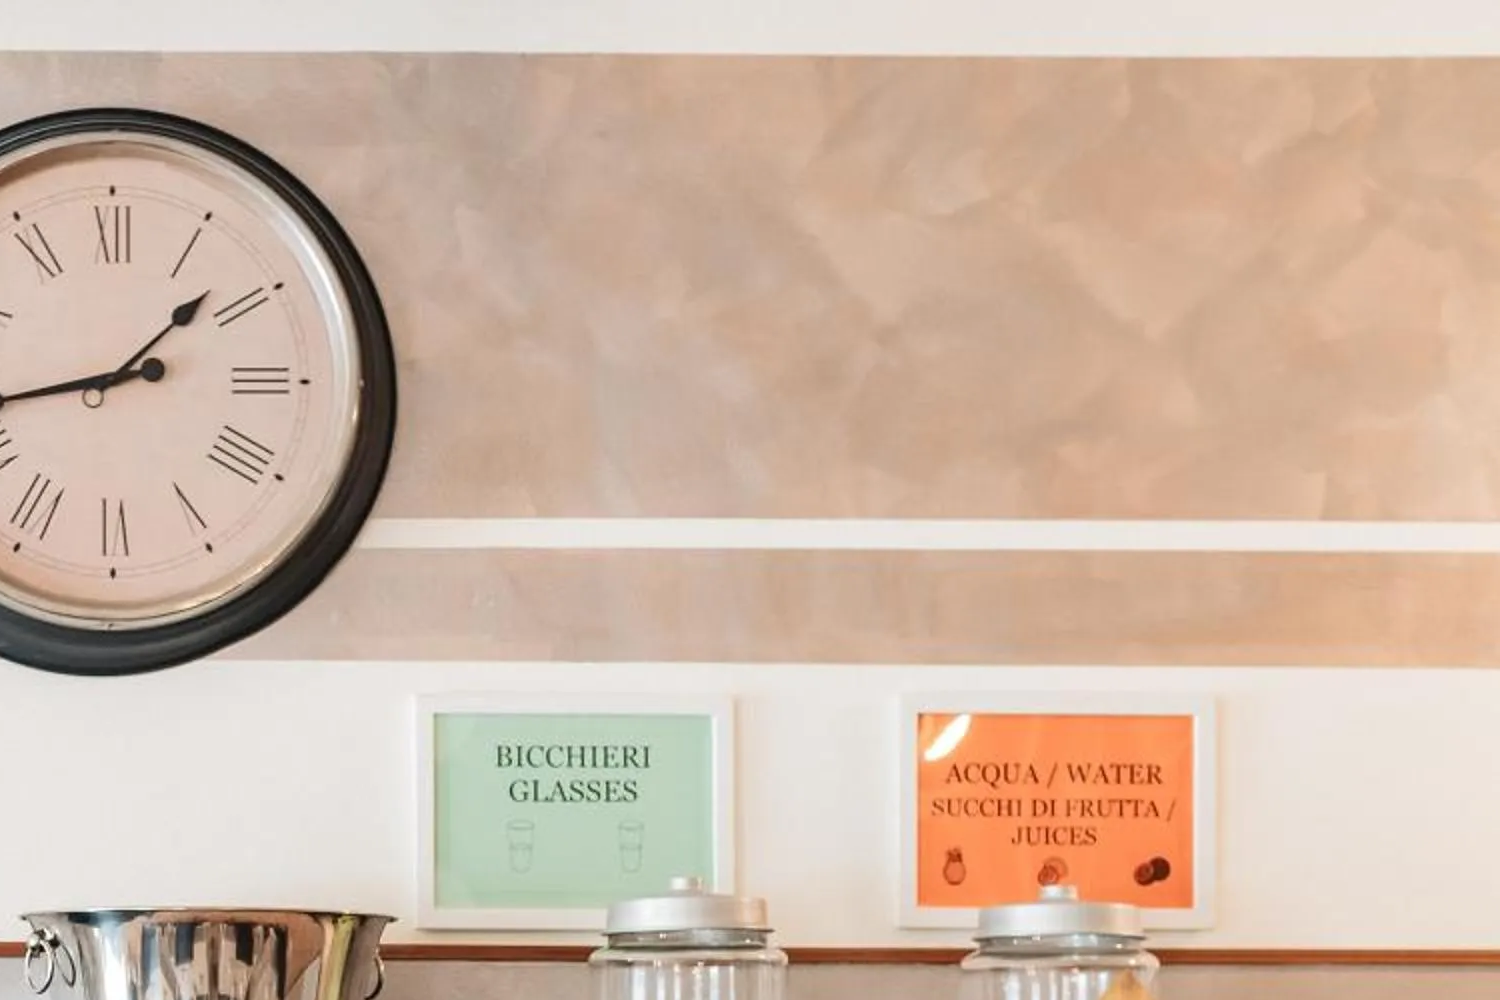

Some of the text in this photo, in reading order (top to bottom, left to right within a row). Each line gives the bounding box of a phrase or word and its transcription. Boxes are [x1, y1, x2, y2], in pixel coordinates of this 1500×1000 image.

[94, 205, 131, 264] XII
[13, 222, 64, 285] XI
[171, 227, 202, 279] I
[213, 287, 269, 328] II
[231, 367, 290, 395] III
[101, 497, 130, 558] VI
[495, 744, 652, 769] BICCHIERI
[945, 762, 1040, 789] ACQUA
[1066, 763, 1164, 785] WATER
[508, 779, 639, 803] GLASSES
[931, 798, 1022, 818] SUCCHI
[1030, 798, 1056, 818] DI
[1065, 799, 1160, 818] FRUTTA
[1011, 825, 1098, 846] JUICES
